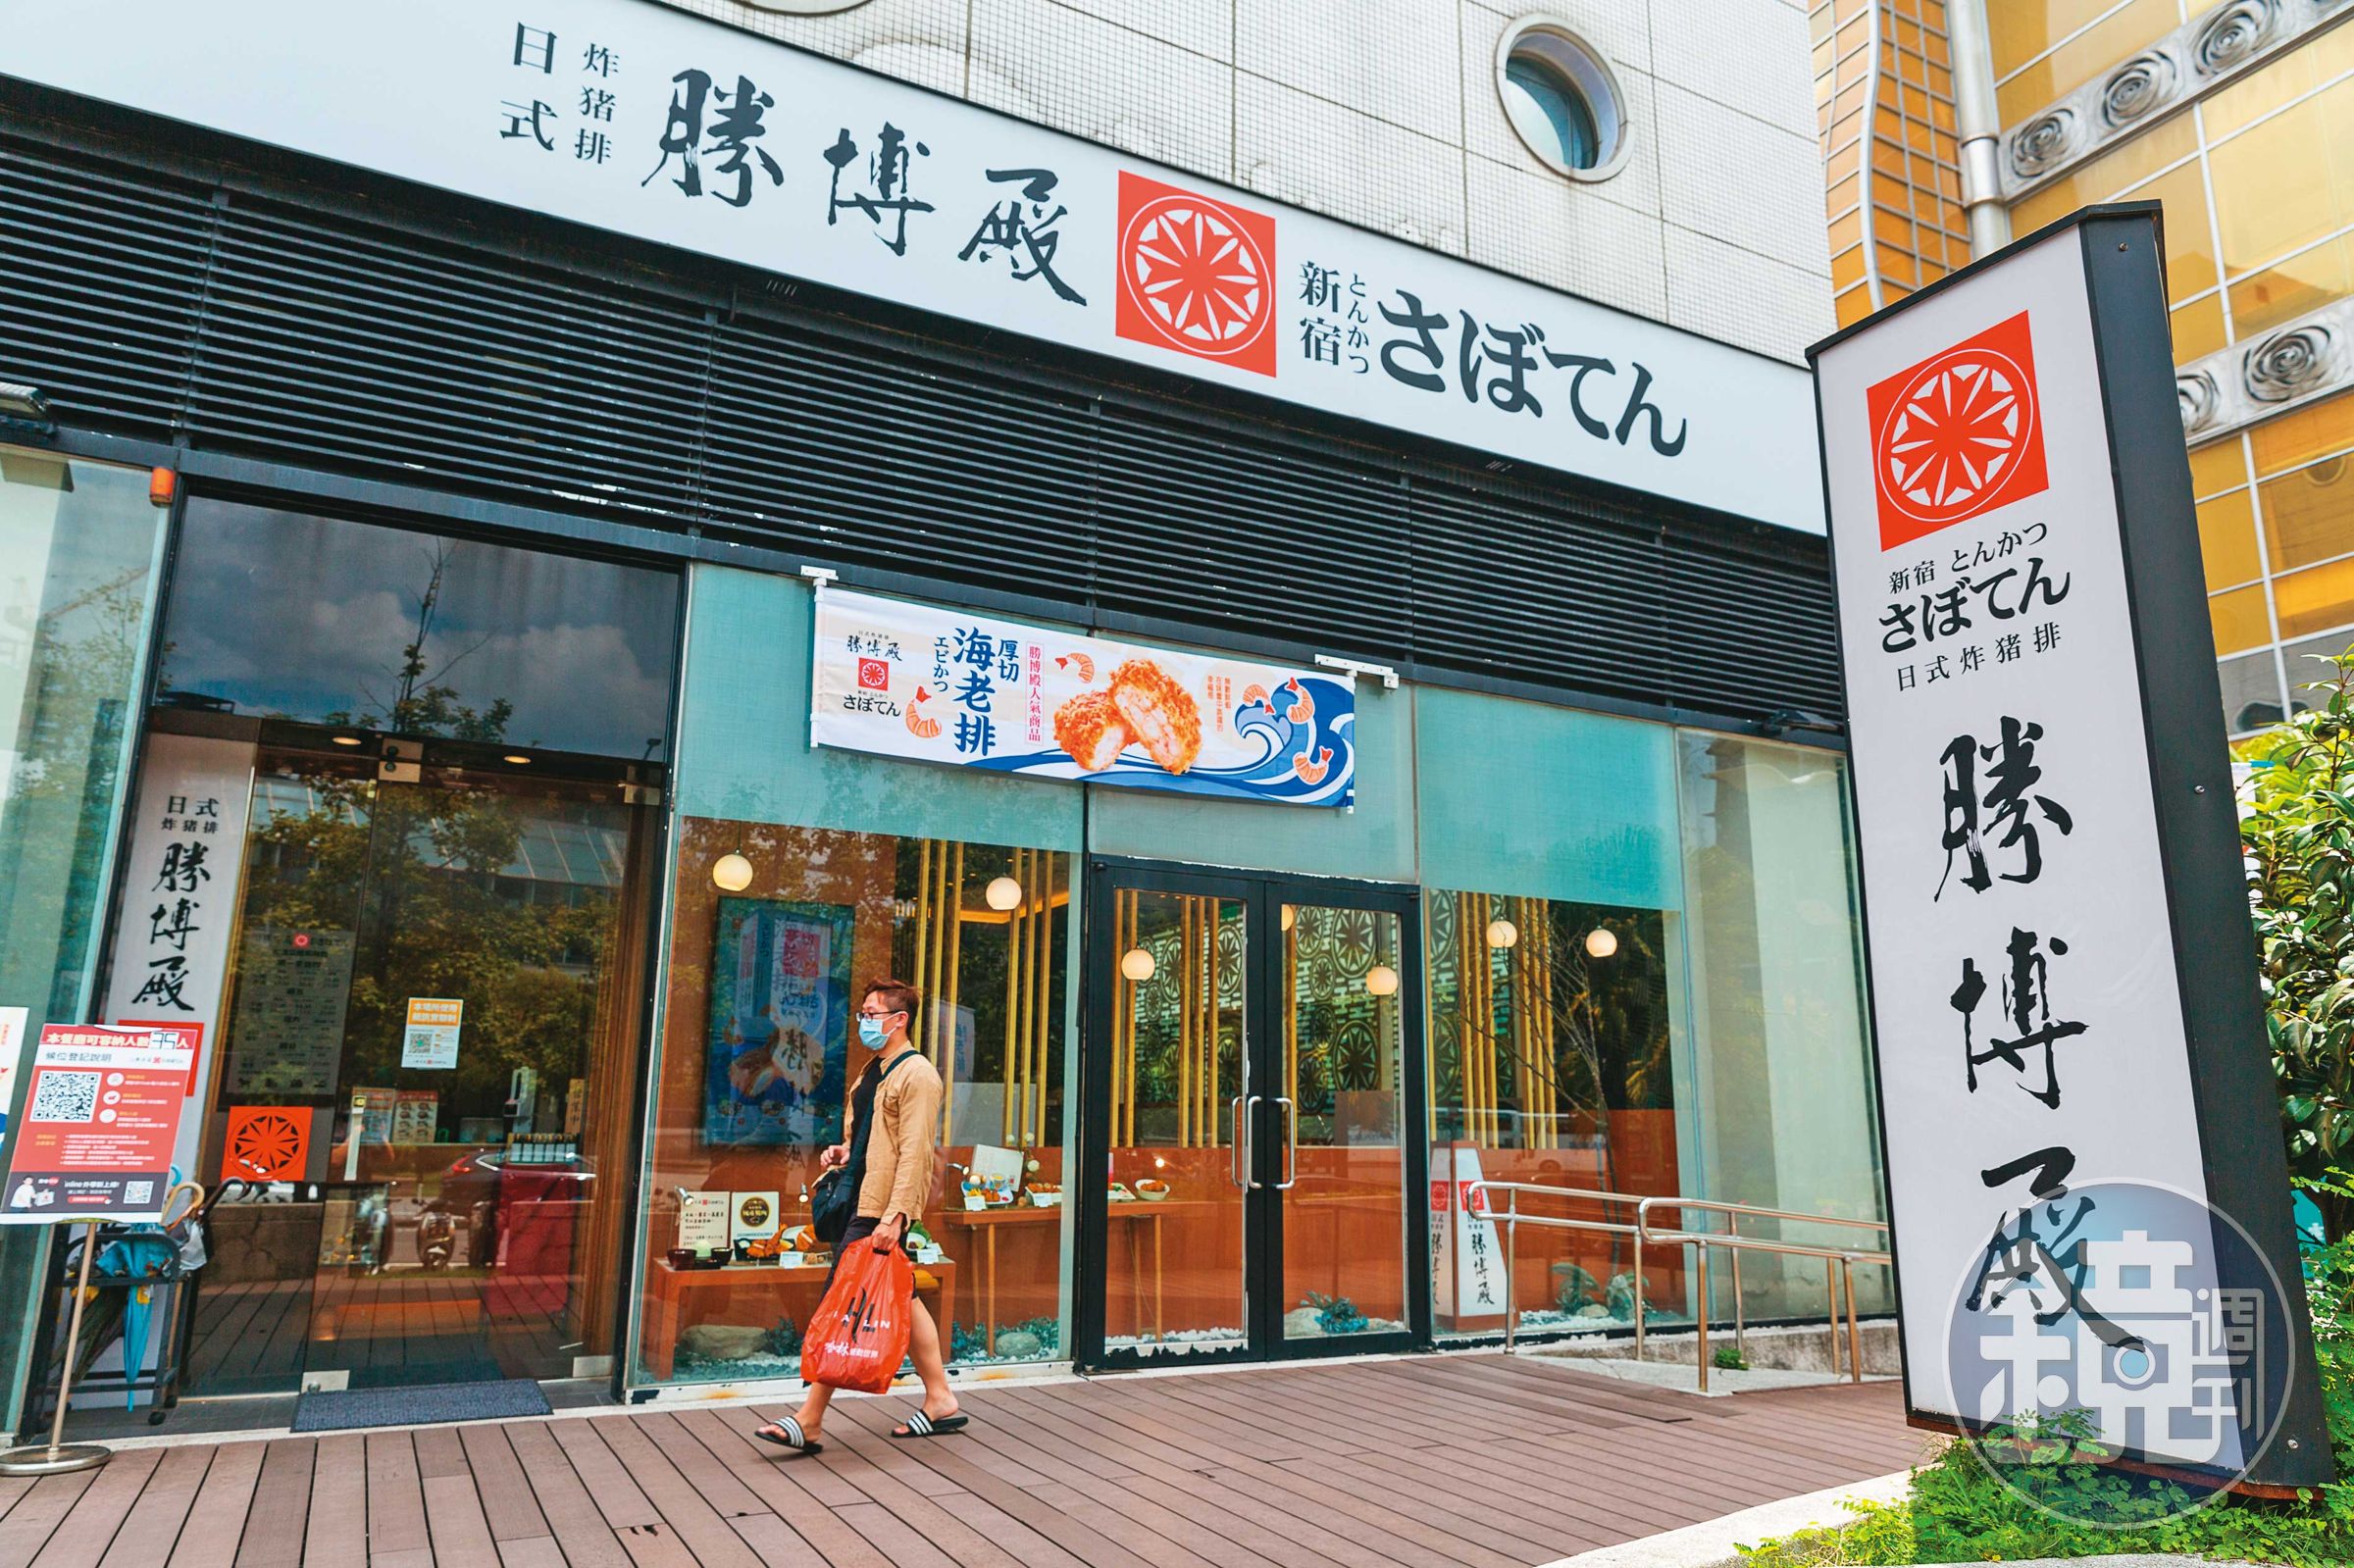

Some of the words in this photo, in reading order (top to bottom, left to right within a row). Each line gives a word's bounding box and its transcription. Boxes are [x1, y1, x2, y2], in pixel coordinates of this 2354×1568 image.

[500, 22, 557, 151] 日式
[641, 68, 1087, 307] 勝博殿
[1299, 261, 1342, 366] 新宿
[1348, 273, 1370, 375] とんかつ
[1377, 288, 1688, 457] さぼてん
[1878, 557, 2071, 654] さぼてん
[1888, 560, 1936, 595] 新宿
[1951, 522, 2048, 573] とんかつ
[846, 634, 903, 662] 勝博殿
[933, 636, 949, 692] エビかつ
[952, 627, 997, 756] 海老排
[998, 639, 1019, 683] 厚切
[844, 694, 901, 717] さぼてん
[168, 795, 220, 818] 日式
[131, 841, 211, 1011] 勝博殿
[1933, 715, 2147, 1352] 勝博殿
